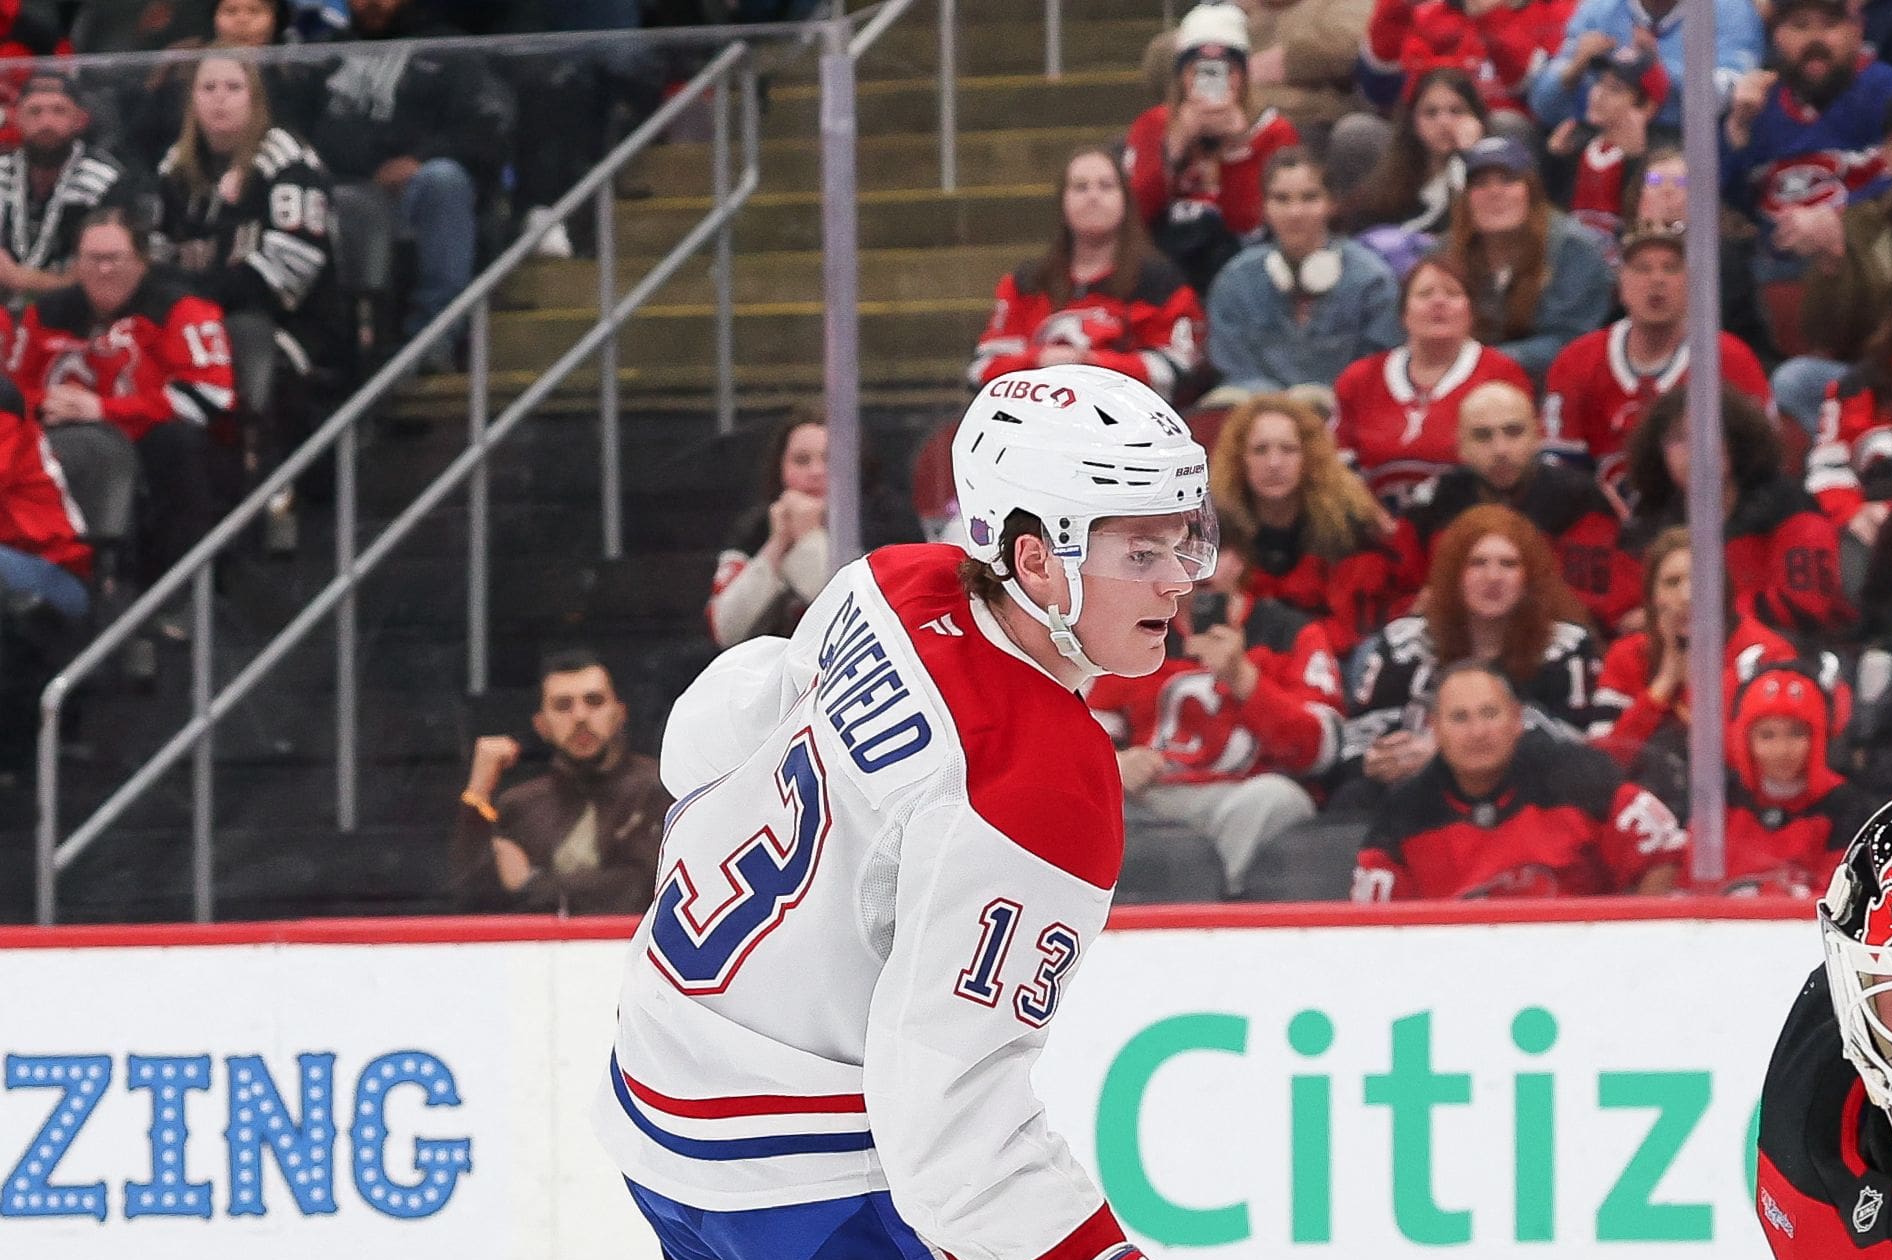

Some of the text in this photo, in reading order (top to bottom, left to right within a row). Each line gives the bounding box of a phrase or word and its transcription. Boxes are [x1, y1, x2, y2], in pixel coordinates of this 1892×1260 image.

[989, 380, 1051, 402] CIBC
[646, 724, 833, 997] 3
[953, 897, 1081, 1029] 13
[0, 1051, 472, 1221] ZING
[1094, 1005, 1758, 1249] Citiz
